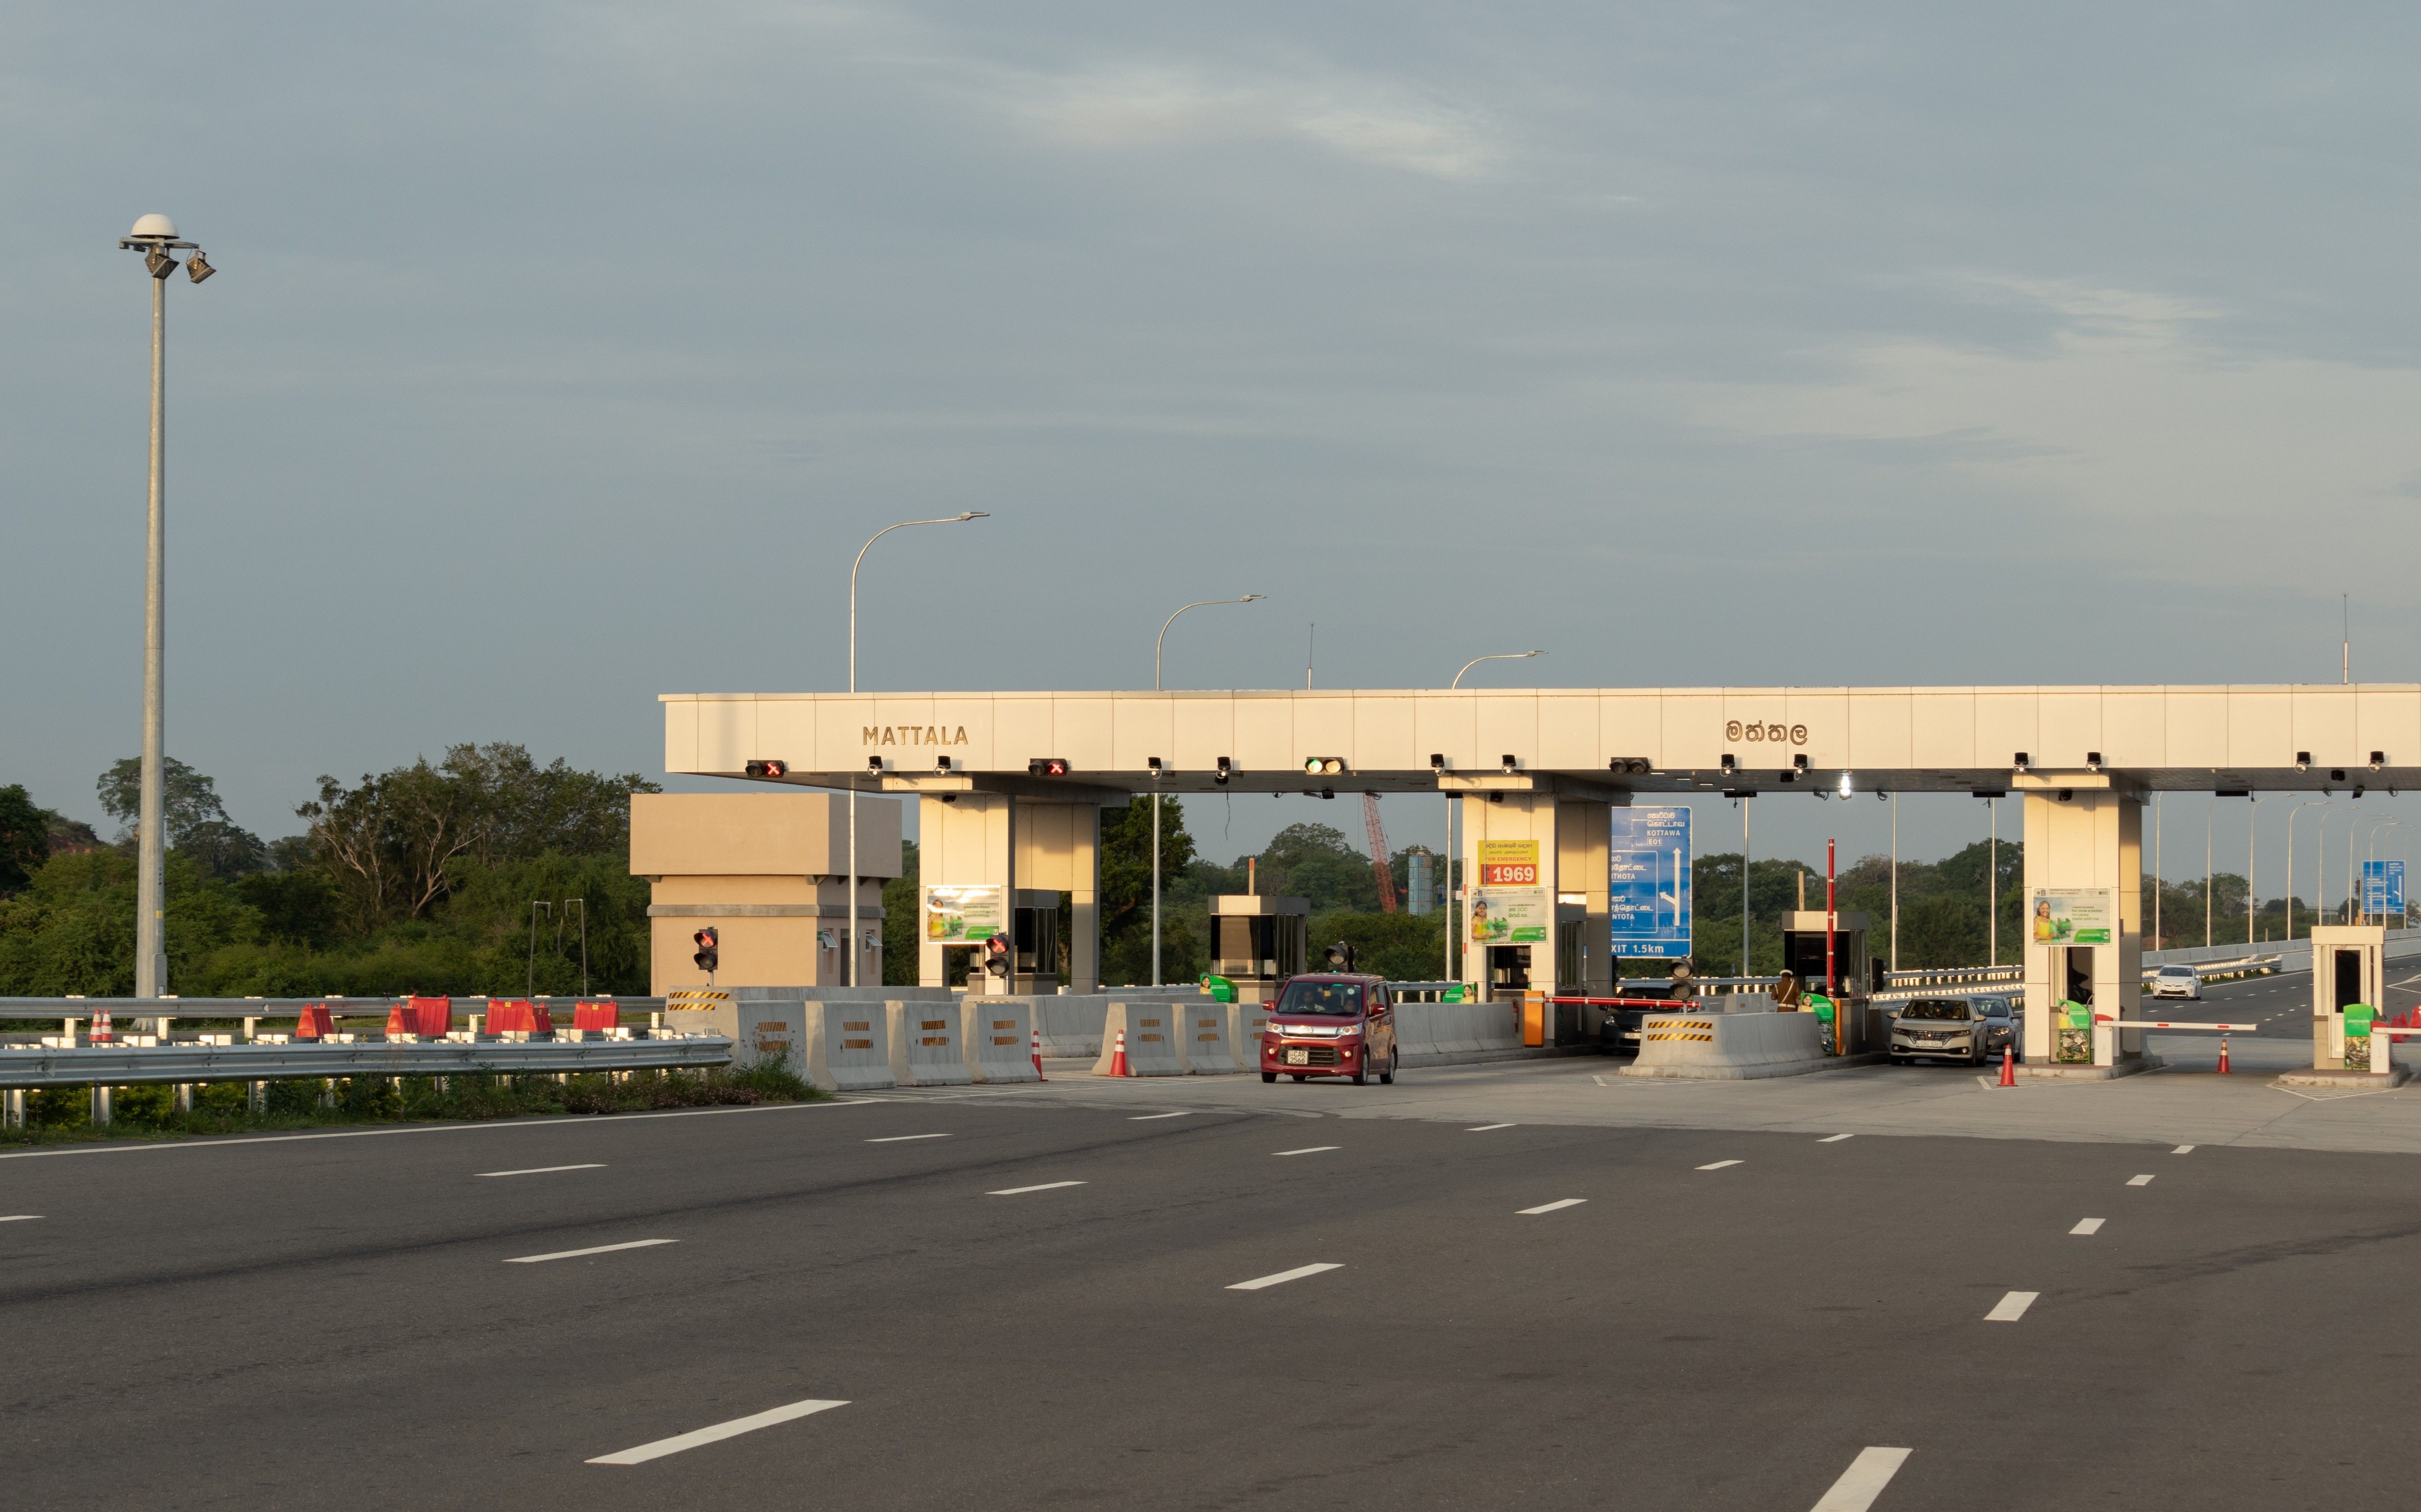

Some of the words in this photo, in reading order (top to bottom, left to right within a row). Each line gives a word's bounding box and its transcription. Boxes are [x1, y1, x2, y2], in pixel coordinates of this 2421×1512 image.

[863, 726, 968, 745] MATTALA
[1726, 720, 1808, 746] මත්තල
[1493, 867, 1535, 882] 1969
[1611, 945, 1627, 953] XIT
[1633, 944, 1664, 953] 1.5km
